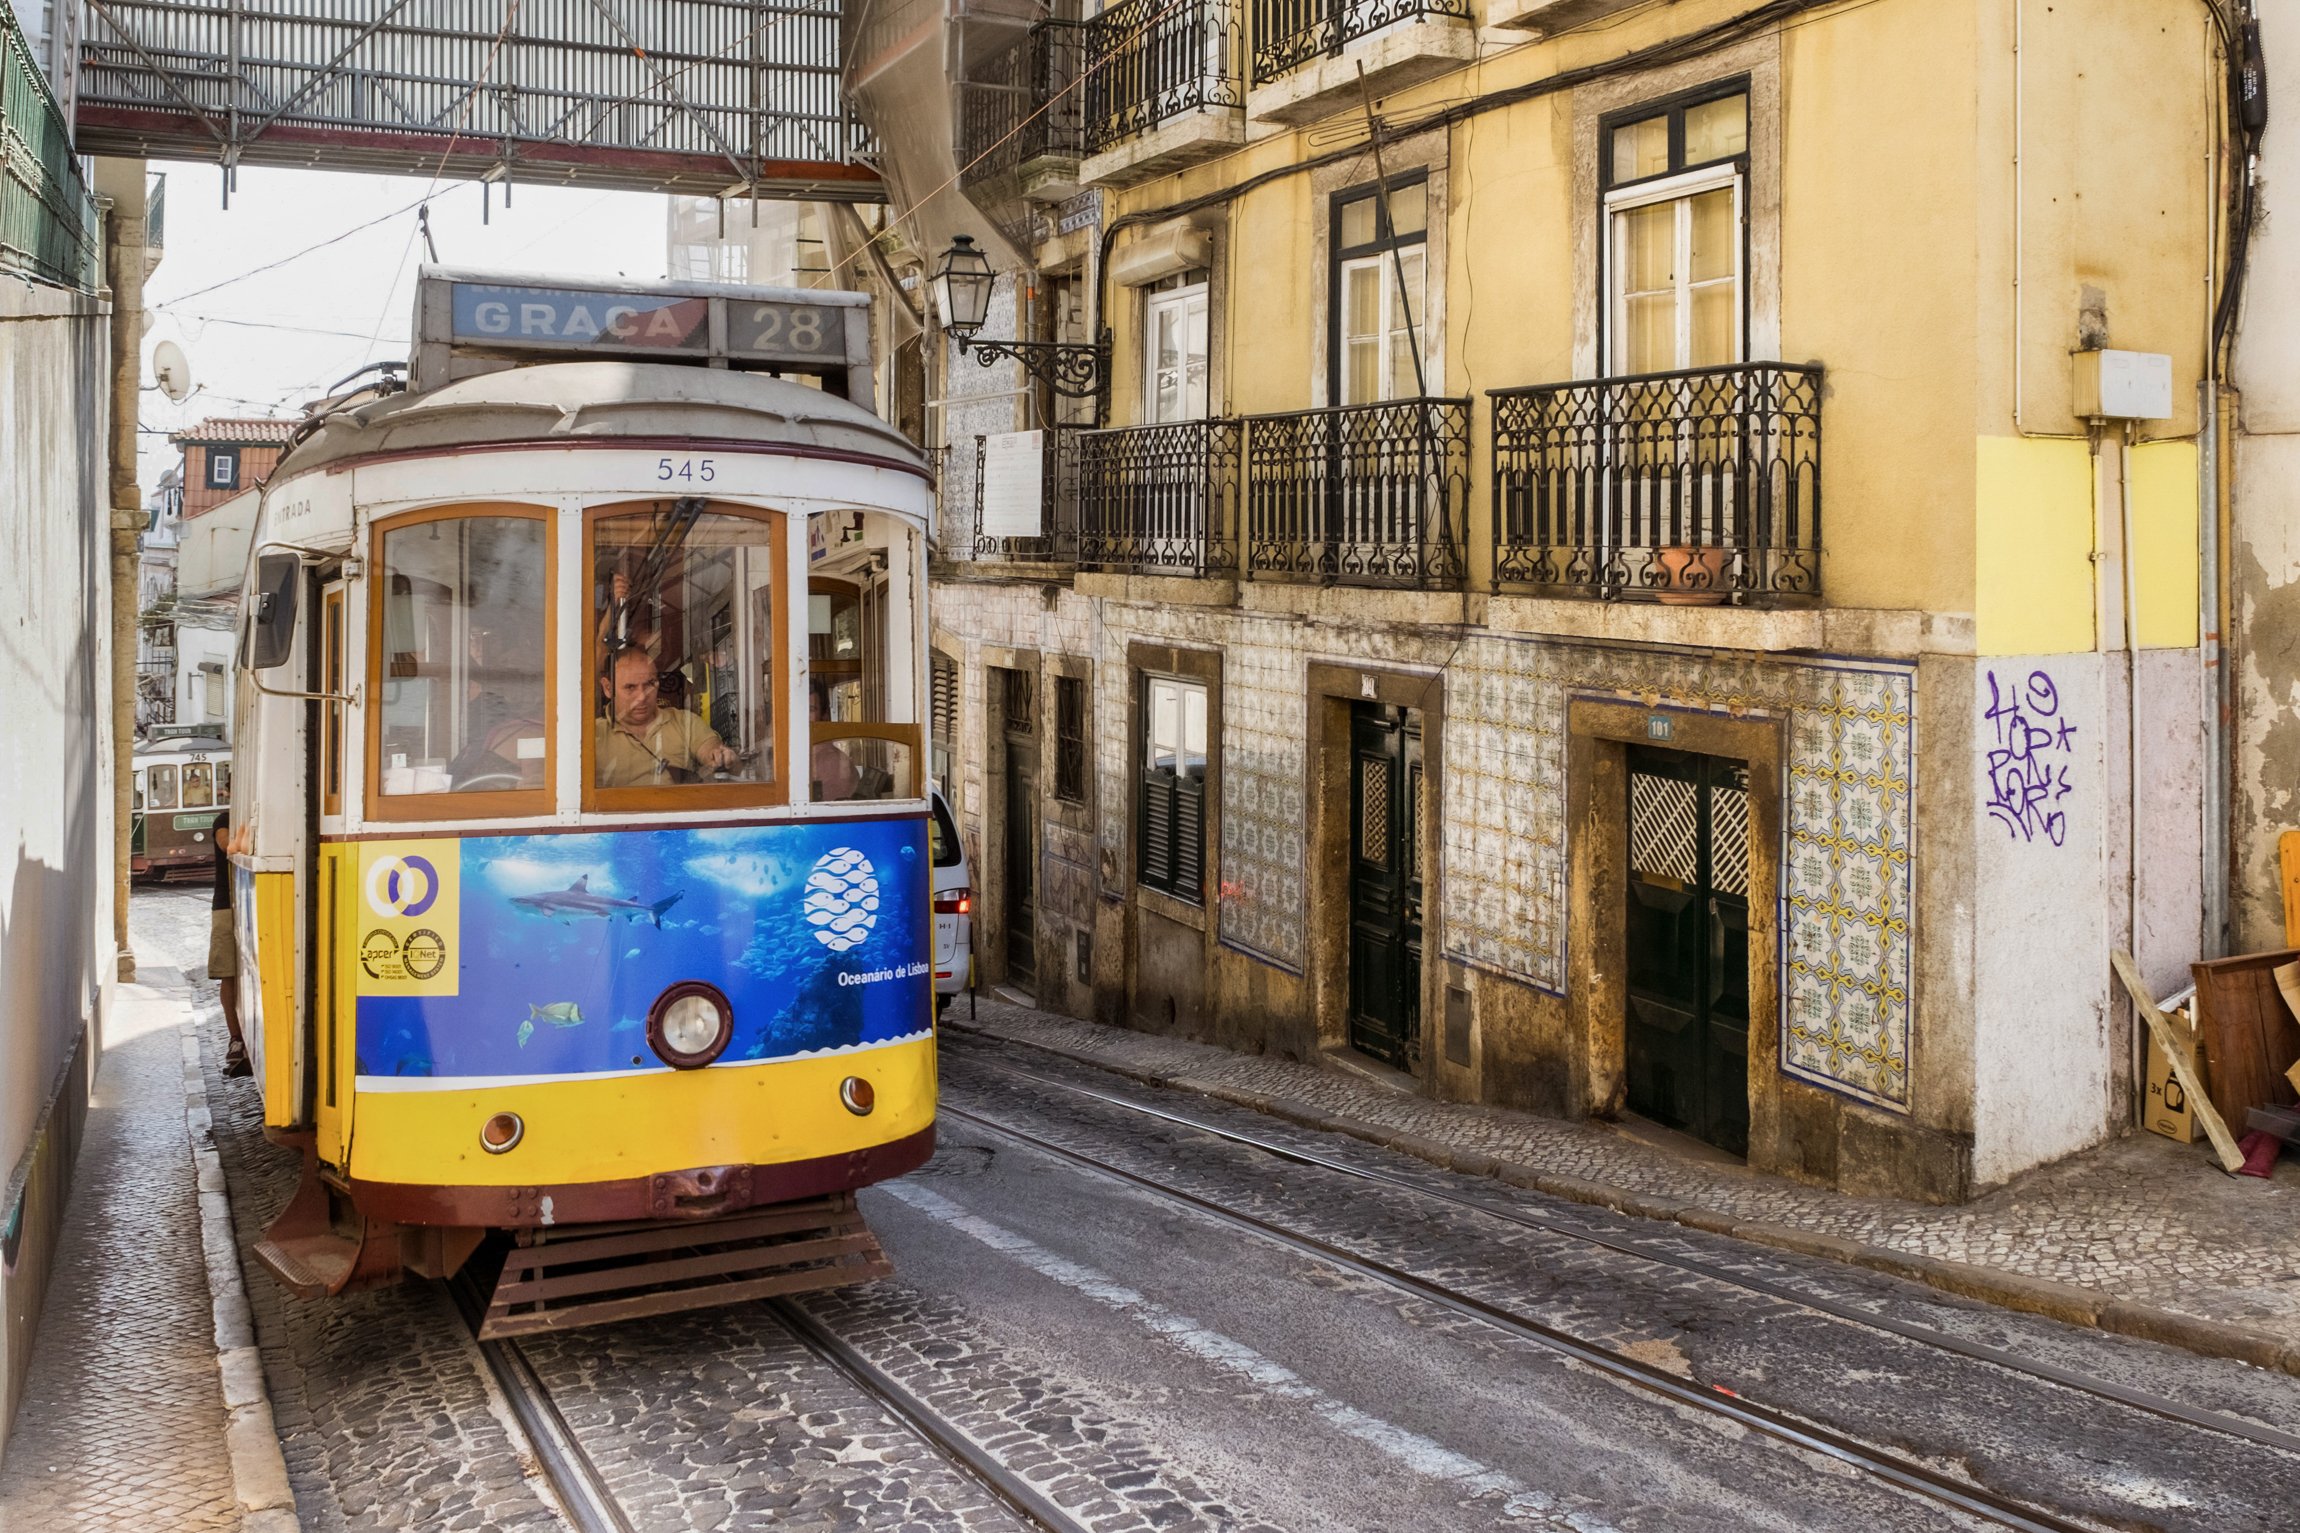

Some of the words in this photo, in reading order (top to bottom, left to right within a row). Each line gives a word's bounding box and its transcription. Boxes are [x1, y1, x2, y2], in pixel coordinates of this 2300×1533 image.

[475, 302, 682, 339] GRAÇA
[753, 307, 822, 352] 28
[658, 458, 714, 482] 545
[1651, 720, 1669, 737] 101
[189, 753, 207, 762] 745
[838, 967, 893, 987] Oceanário
[895, 965, 906, 979] de
[907, 961, 929, 976] Lisboa
[2151, 1082, 2162, 1096] 3x
